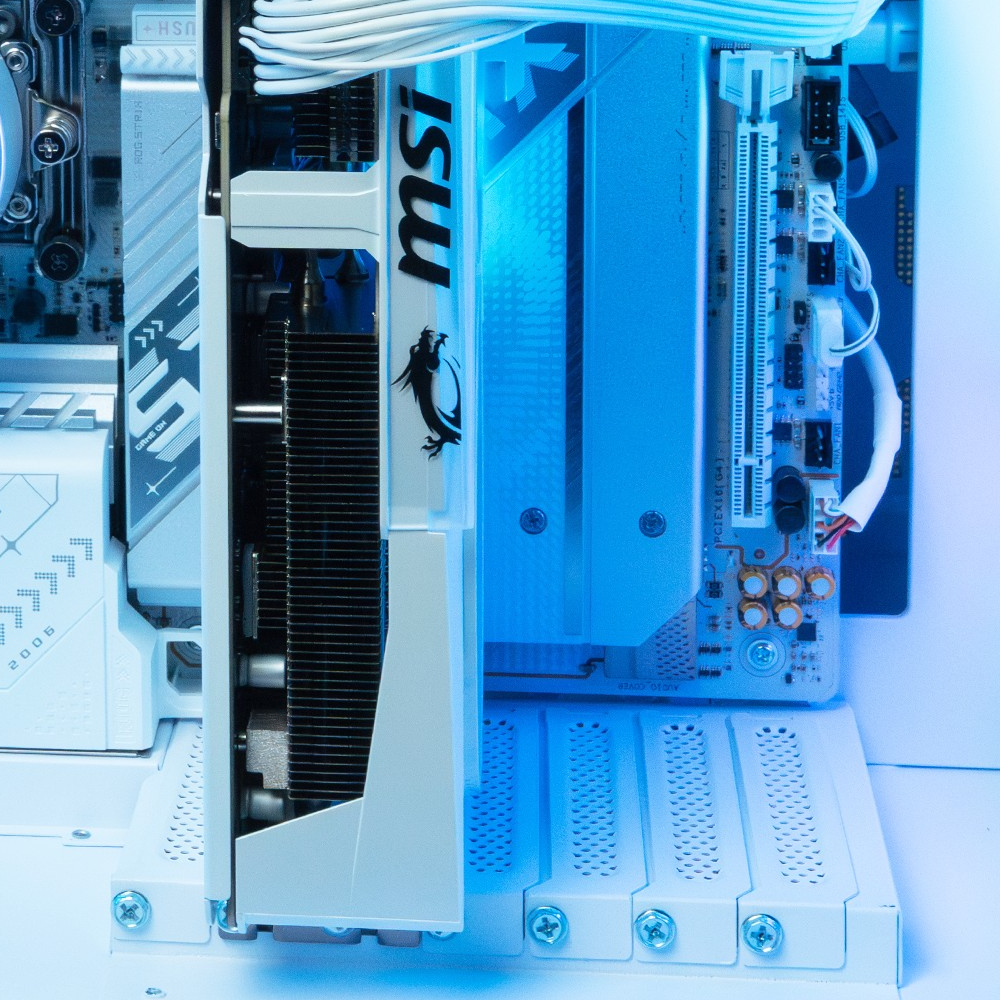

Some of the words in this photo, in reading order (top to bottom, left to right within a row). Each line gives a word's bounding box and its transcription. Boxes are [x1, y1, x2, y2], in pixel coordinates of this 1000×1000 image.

[158, 21, 196, 36] USH
[134, 142, 143, 165] ROG
[398, 84, 452, 289] msi
[135, 429, 157, 451] GAME
[155, 420, 168, 432] ON
[8, 624, 57, 670] 2006
